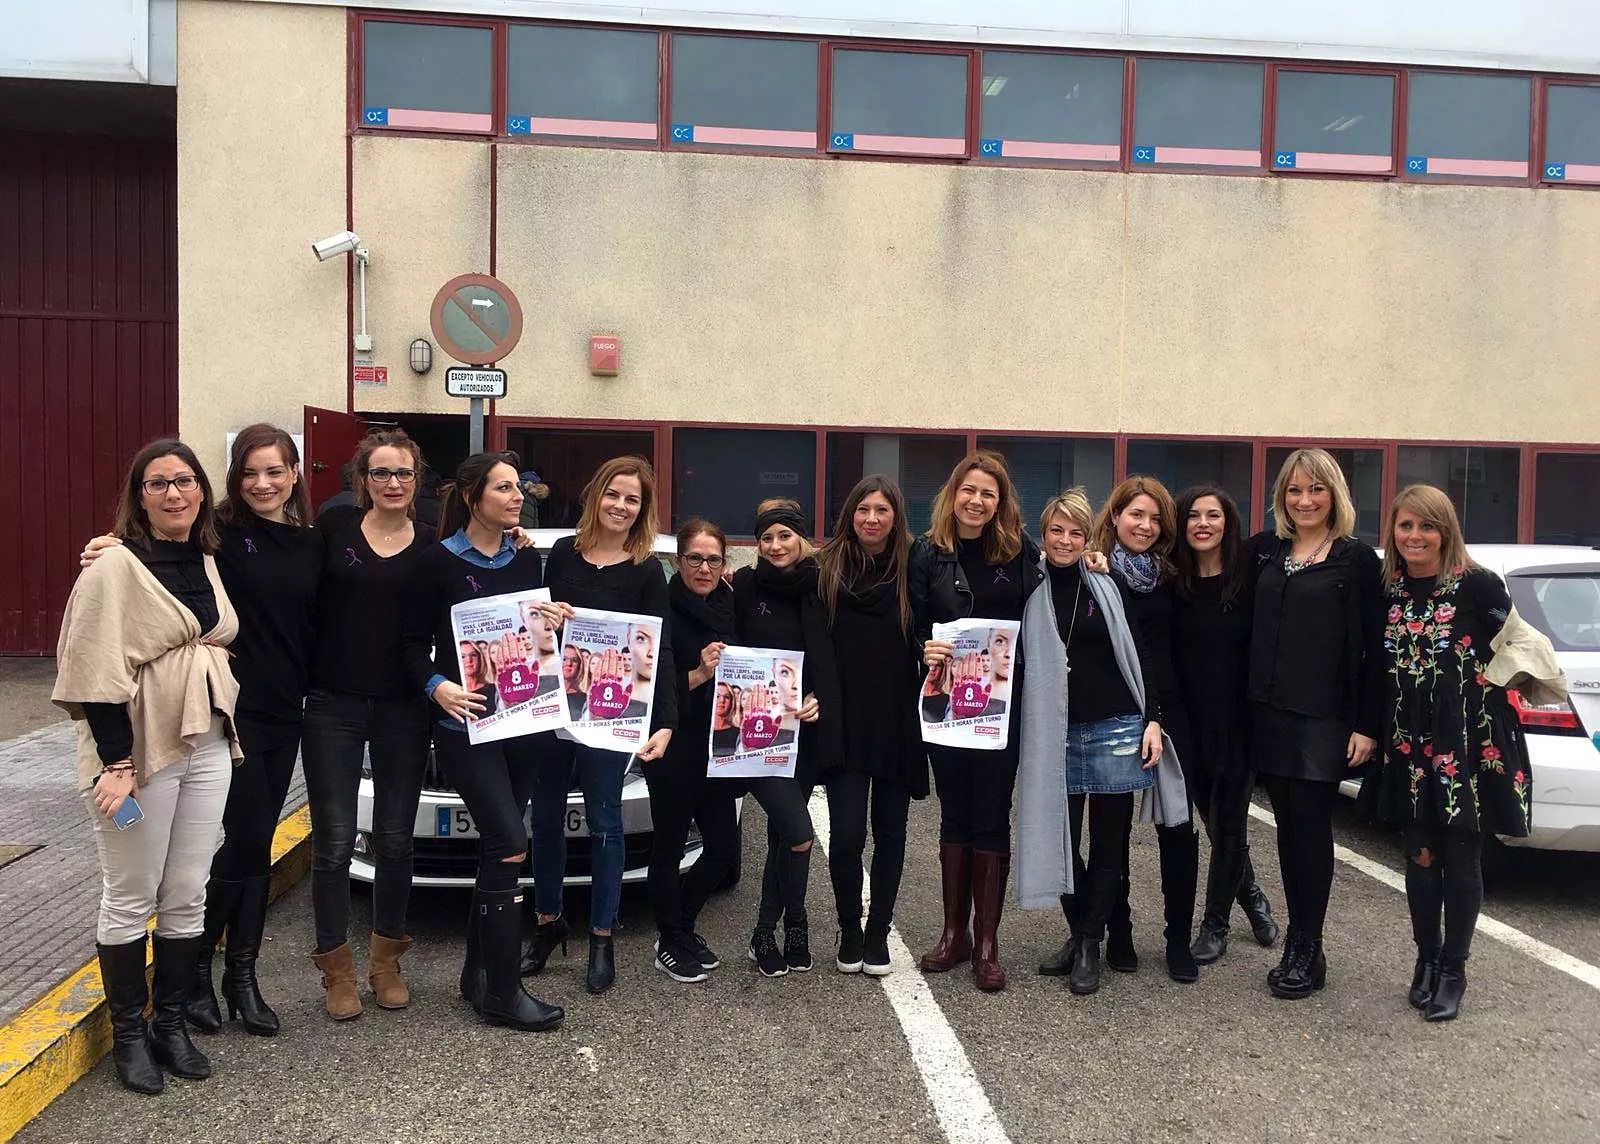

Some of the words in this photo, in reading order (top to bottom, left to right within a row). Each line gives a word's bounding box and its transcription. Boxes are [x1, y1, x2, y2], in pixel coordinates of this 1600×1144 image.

[451, 372, 474, 381] EXCEPTO
[476, 374, 502, 382] VEHICULOS
[460, 384, 494, 392] AUTORIZADOS
[486, 623, 513, 632] IGUALDAD
[512, 670, 521, 684] 8
[513, 683, 534, 692] MARZO
[603, 686, 613, 700] 8
[965, 687, 974, 700] 8
[476, 718, 496, 728] HUELGA
[511, 704, 528, 714] HORAS
[540, 692, 558, 702] TURNO
[533, 707, 554, 715] CCOO
[755, 719, 764, 732] 8
[775, 745, 791, 753] TURNO
